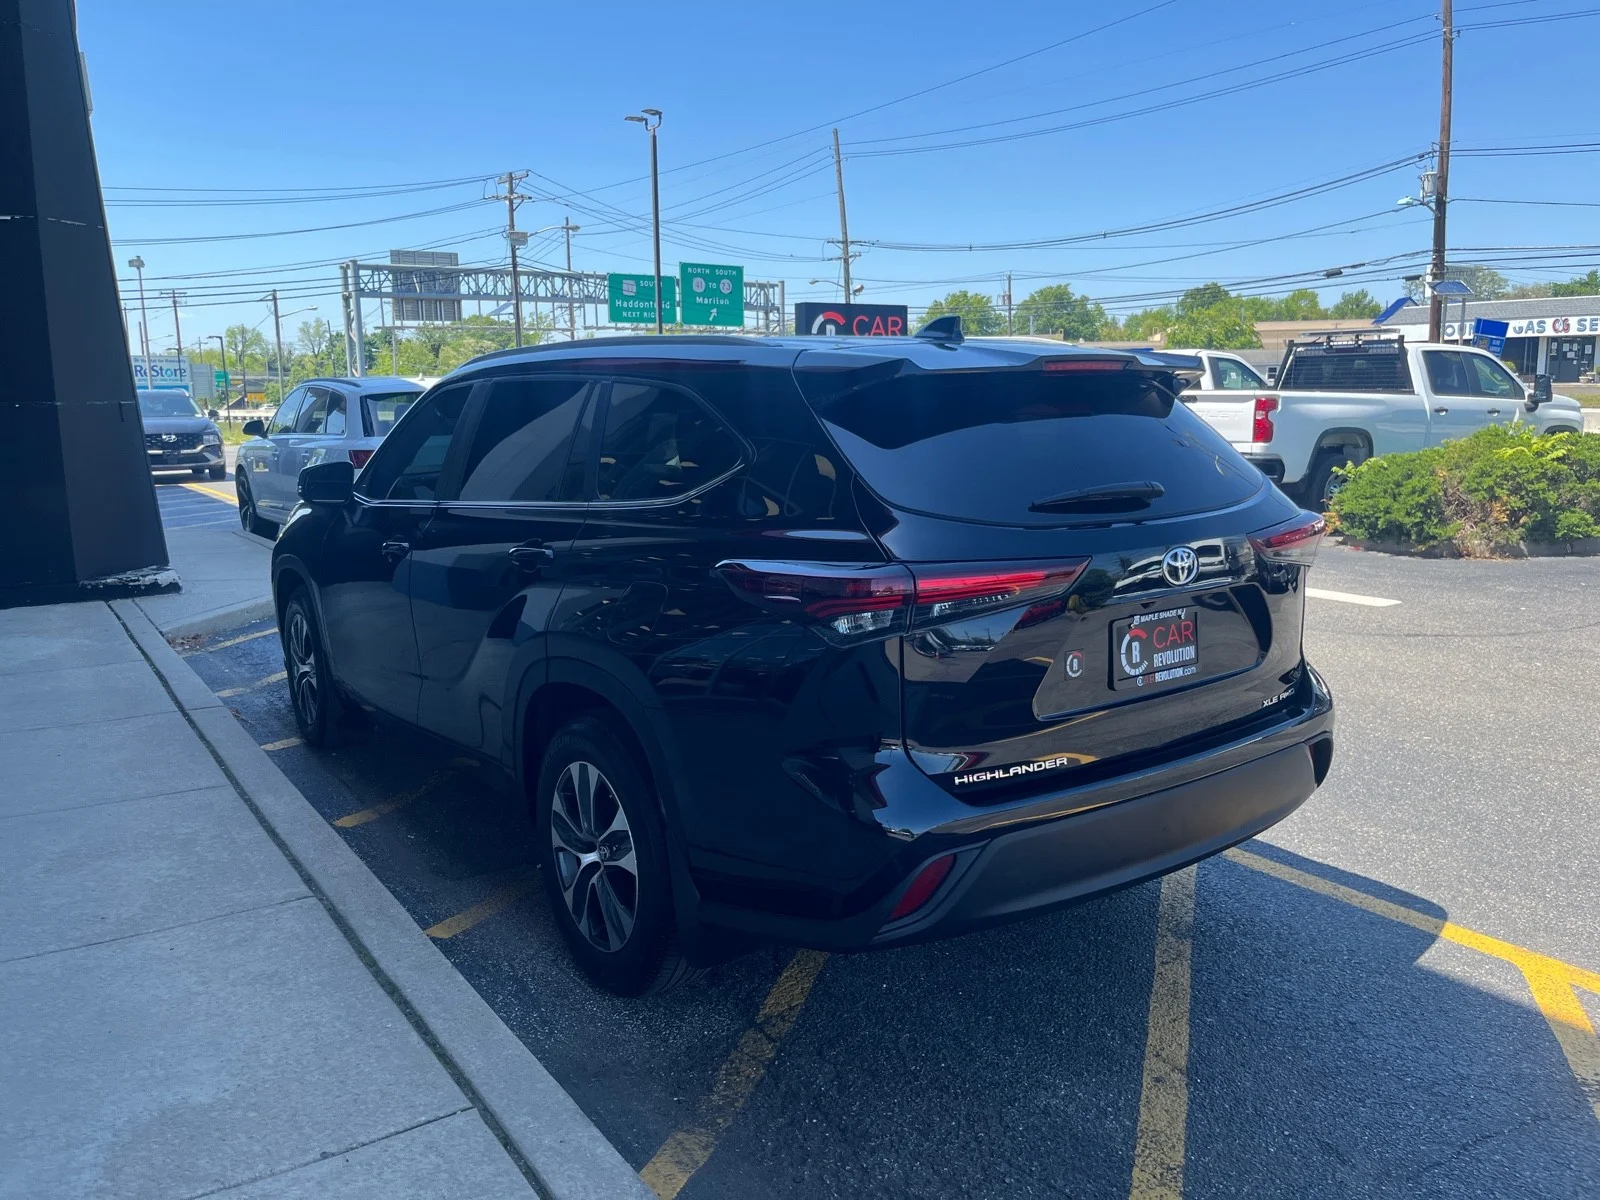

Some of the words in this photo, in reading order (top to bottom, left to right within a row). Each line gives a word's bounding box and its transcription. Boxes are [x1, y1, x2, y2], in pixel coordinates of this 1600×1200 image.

[687, 267, 710, 275] NORTH
[715, 268, 737, 276] SOUTH
[639, 280, 662, 288] SOU
[695, 296, 730, 305] Marlton
[643, 311, 664, 319] RIG
[852, 315, 903, 336] CAR
[1140, 613, 1159, 622] MAPLE
[1159, 609, 1177, 619] SHADE
[1153, 620, 1194, 649] CAR
[1153, 645, 1195, 668] REVOLUTION
[1262, 695, 1279, 708] XLE
[954, 757, 1067, 785] HIGHLANDER
